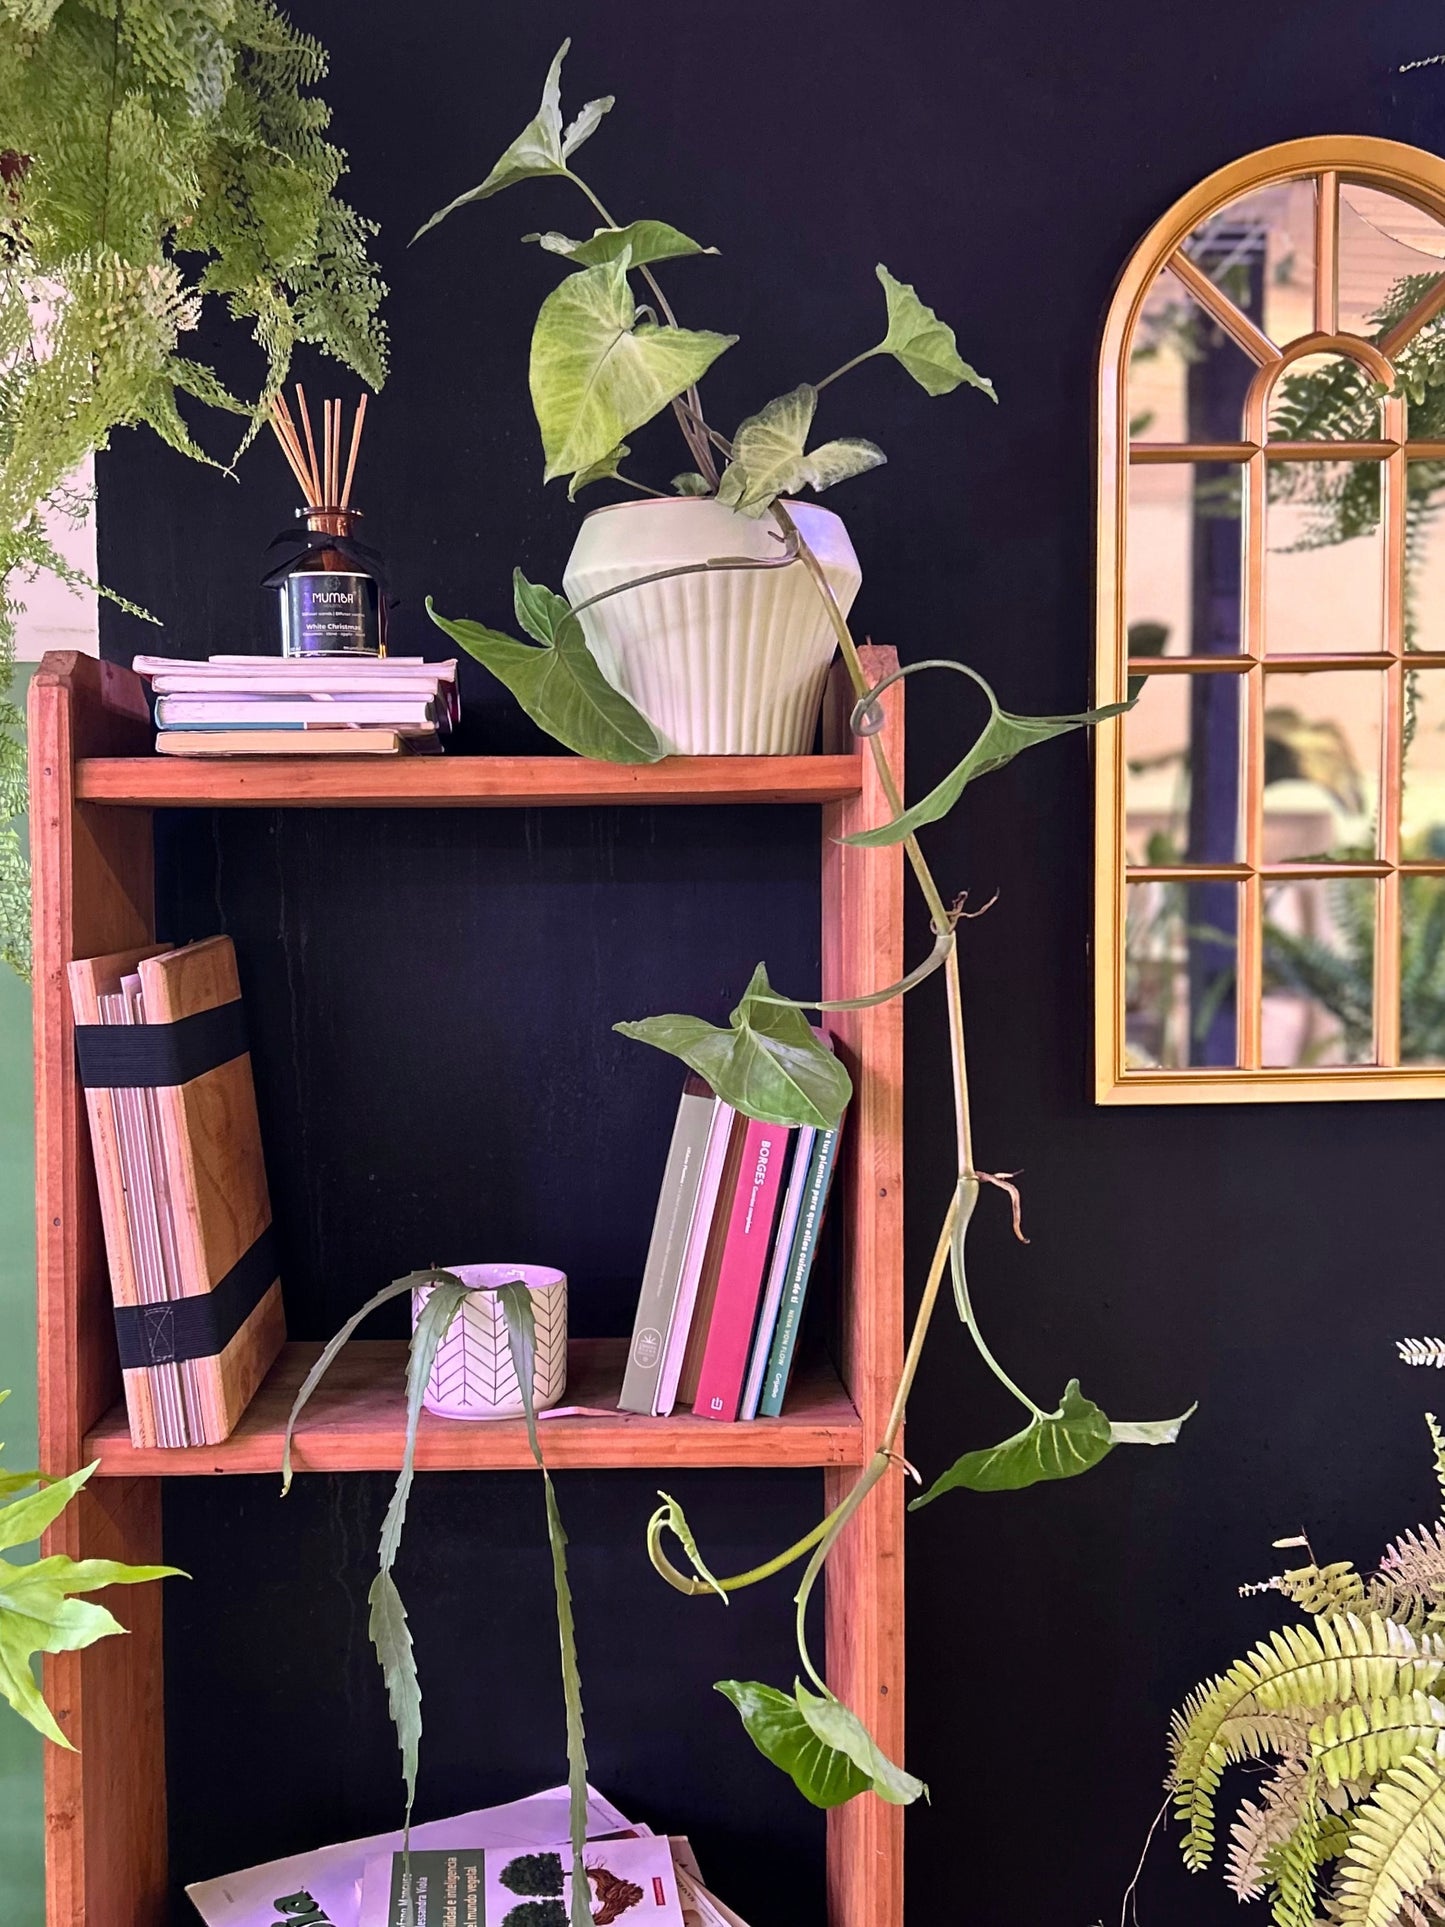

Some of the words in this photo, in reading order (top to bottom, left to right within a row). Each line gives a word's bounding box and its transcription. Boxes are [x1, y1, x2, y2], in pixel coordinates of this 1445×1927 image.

[822, 1140, 832, 1154] tus
[754, 1139, 772, 1186] BORGES
[815, 1154, 828, 1189] plantas
[810, 1189, 820, 1211] para
[806, 1211, 815, 1229] que
[801, 1229, 812, 1252] ellas
[795, 1252, 807, 1282] cuiden
[792, 1281, 801, 1295] de
[790, 1296, 799, 1304] ti
[785, 1309, 795, 1329] NENA
[782, 1329, 791, 1347] VON
[778, 1346, 788, 1366] FLOW
[415, 1876, 428, 1894] Viola
[443, 1857, 460, 1899] inteligencia
[463, 1866, 481, 1893] vegetal
[463, 1894, 478, 1920] mundo
